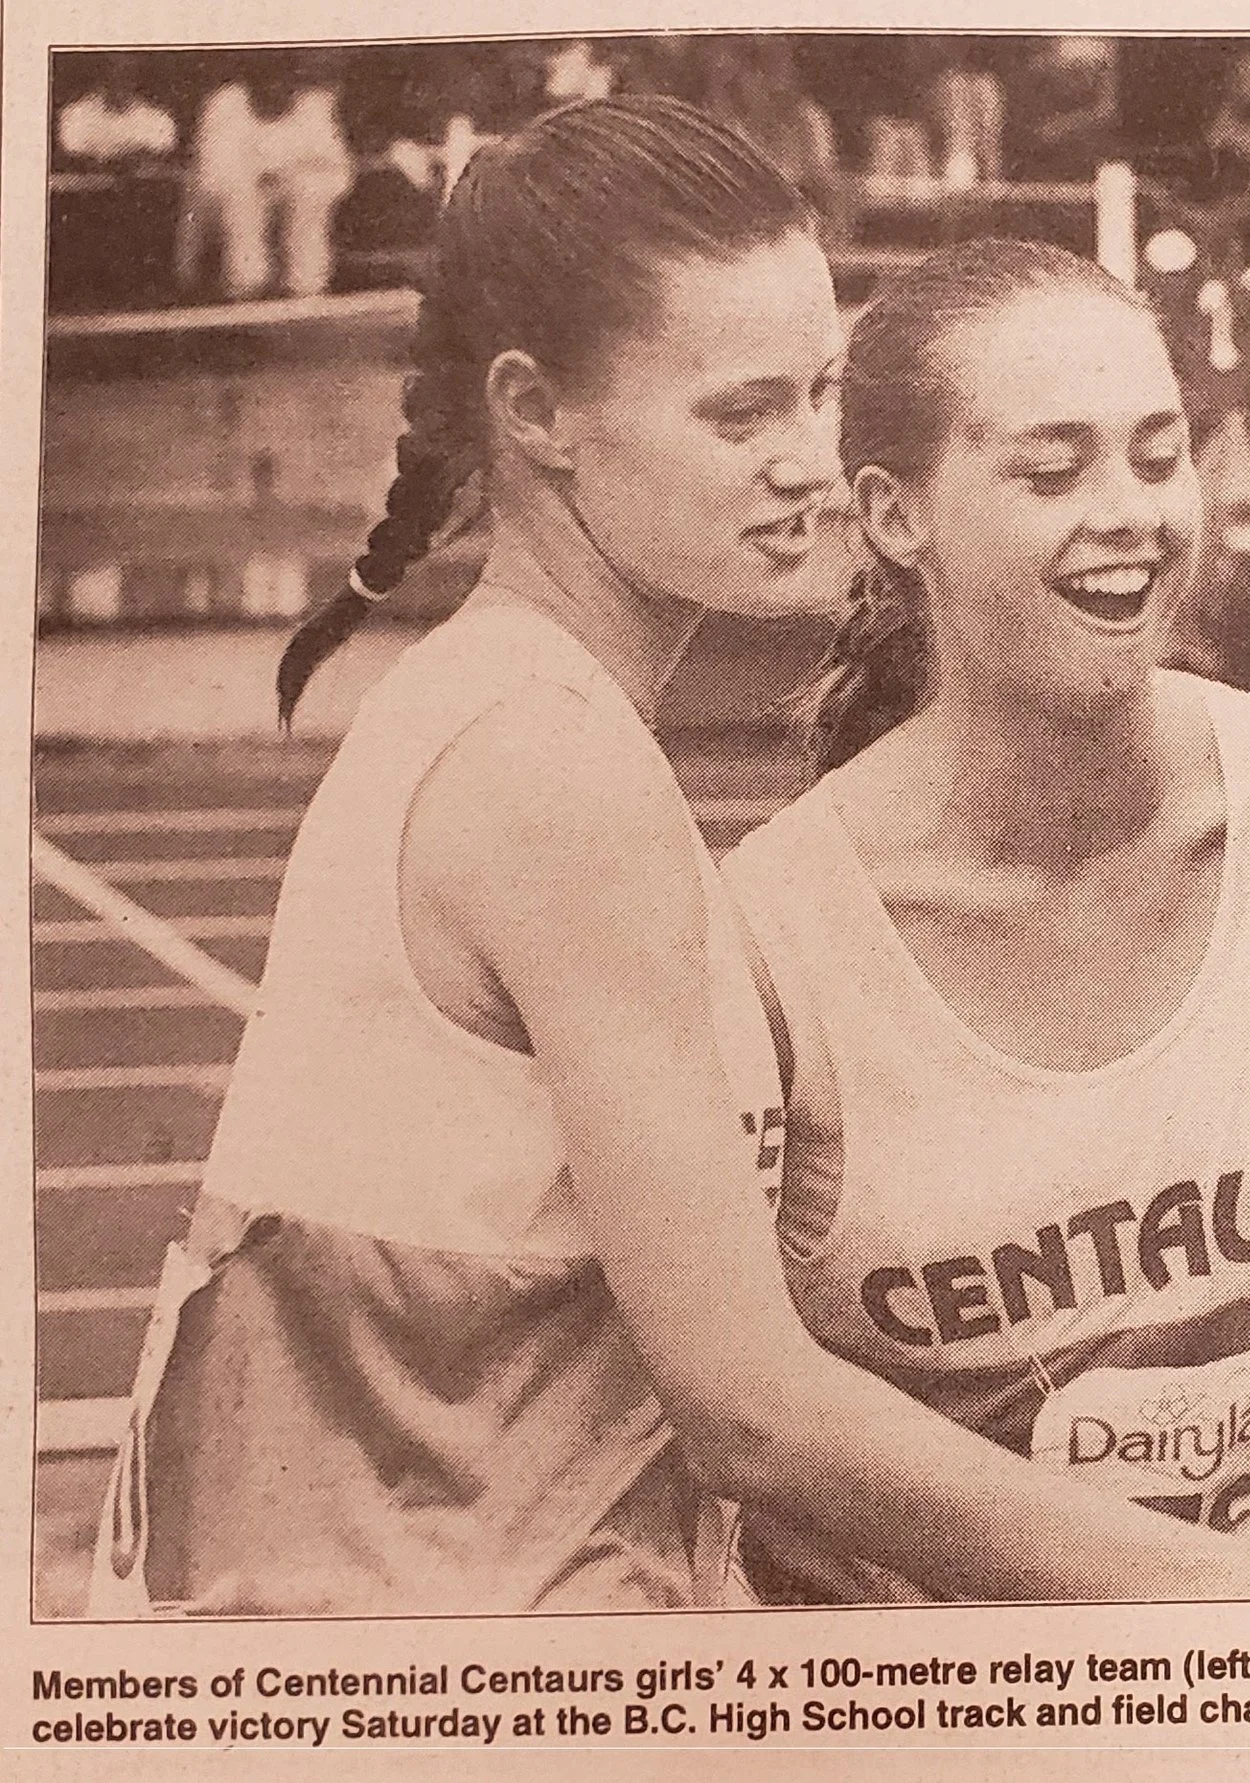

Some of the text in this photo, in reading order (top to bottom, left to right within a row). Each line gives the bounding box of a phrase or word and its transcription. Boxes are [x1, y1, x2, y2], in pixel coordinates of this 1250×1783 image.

[33, 1669, 198, 1700] Members
[210, 1667, 245, 1698] of
[256, 1664, 448, 1698] Centennial
[460, 1664, 624, 1695] Centaurs
[736, 1659, 757, 1690] 4
[768, 1665, 789, 1689] x
[800, 1657, 978, 1688] 100-metre
[989, 1652, 1075, 1691] relay
[1086, 1653, 1171, 1682] team
[32, 1711, 198, 1743] celebrate
[207, 1710, 331, 1747] victory
[342, 1707, 502, 1745] Saturday
[512, 1708, 546, 1737] at
[556, 1705, 612, 1736] the
[624, 1703, 696, 1735] B.C.
[710, 1701, 791, 1741] High
[802, 1698, 925, 1732] School
[936, 1696, 1027, 1729] track
[1036, 1695, 1102, 1727] and
[1111, 1693, 1188, 1725] field
